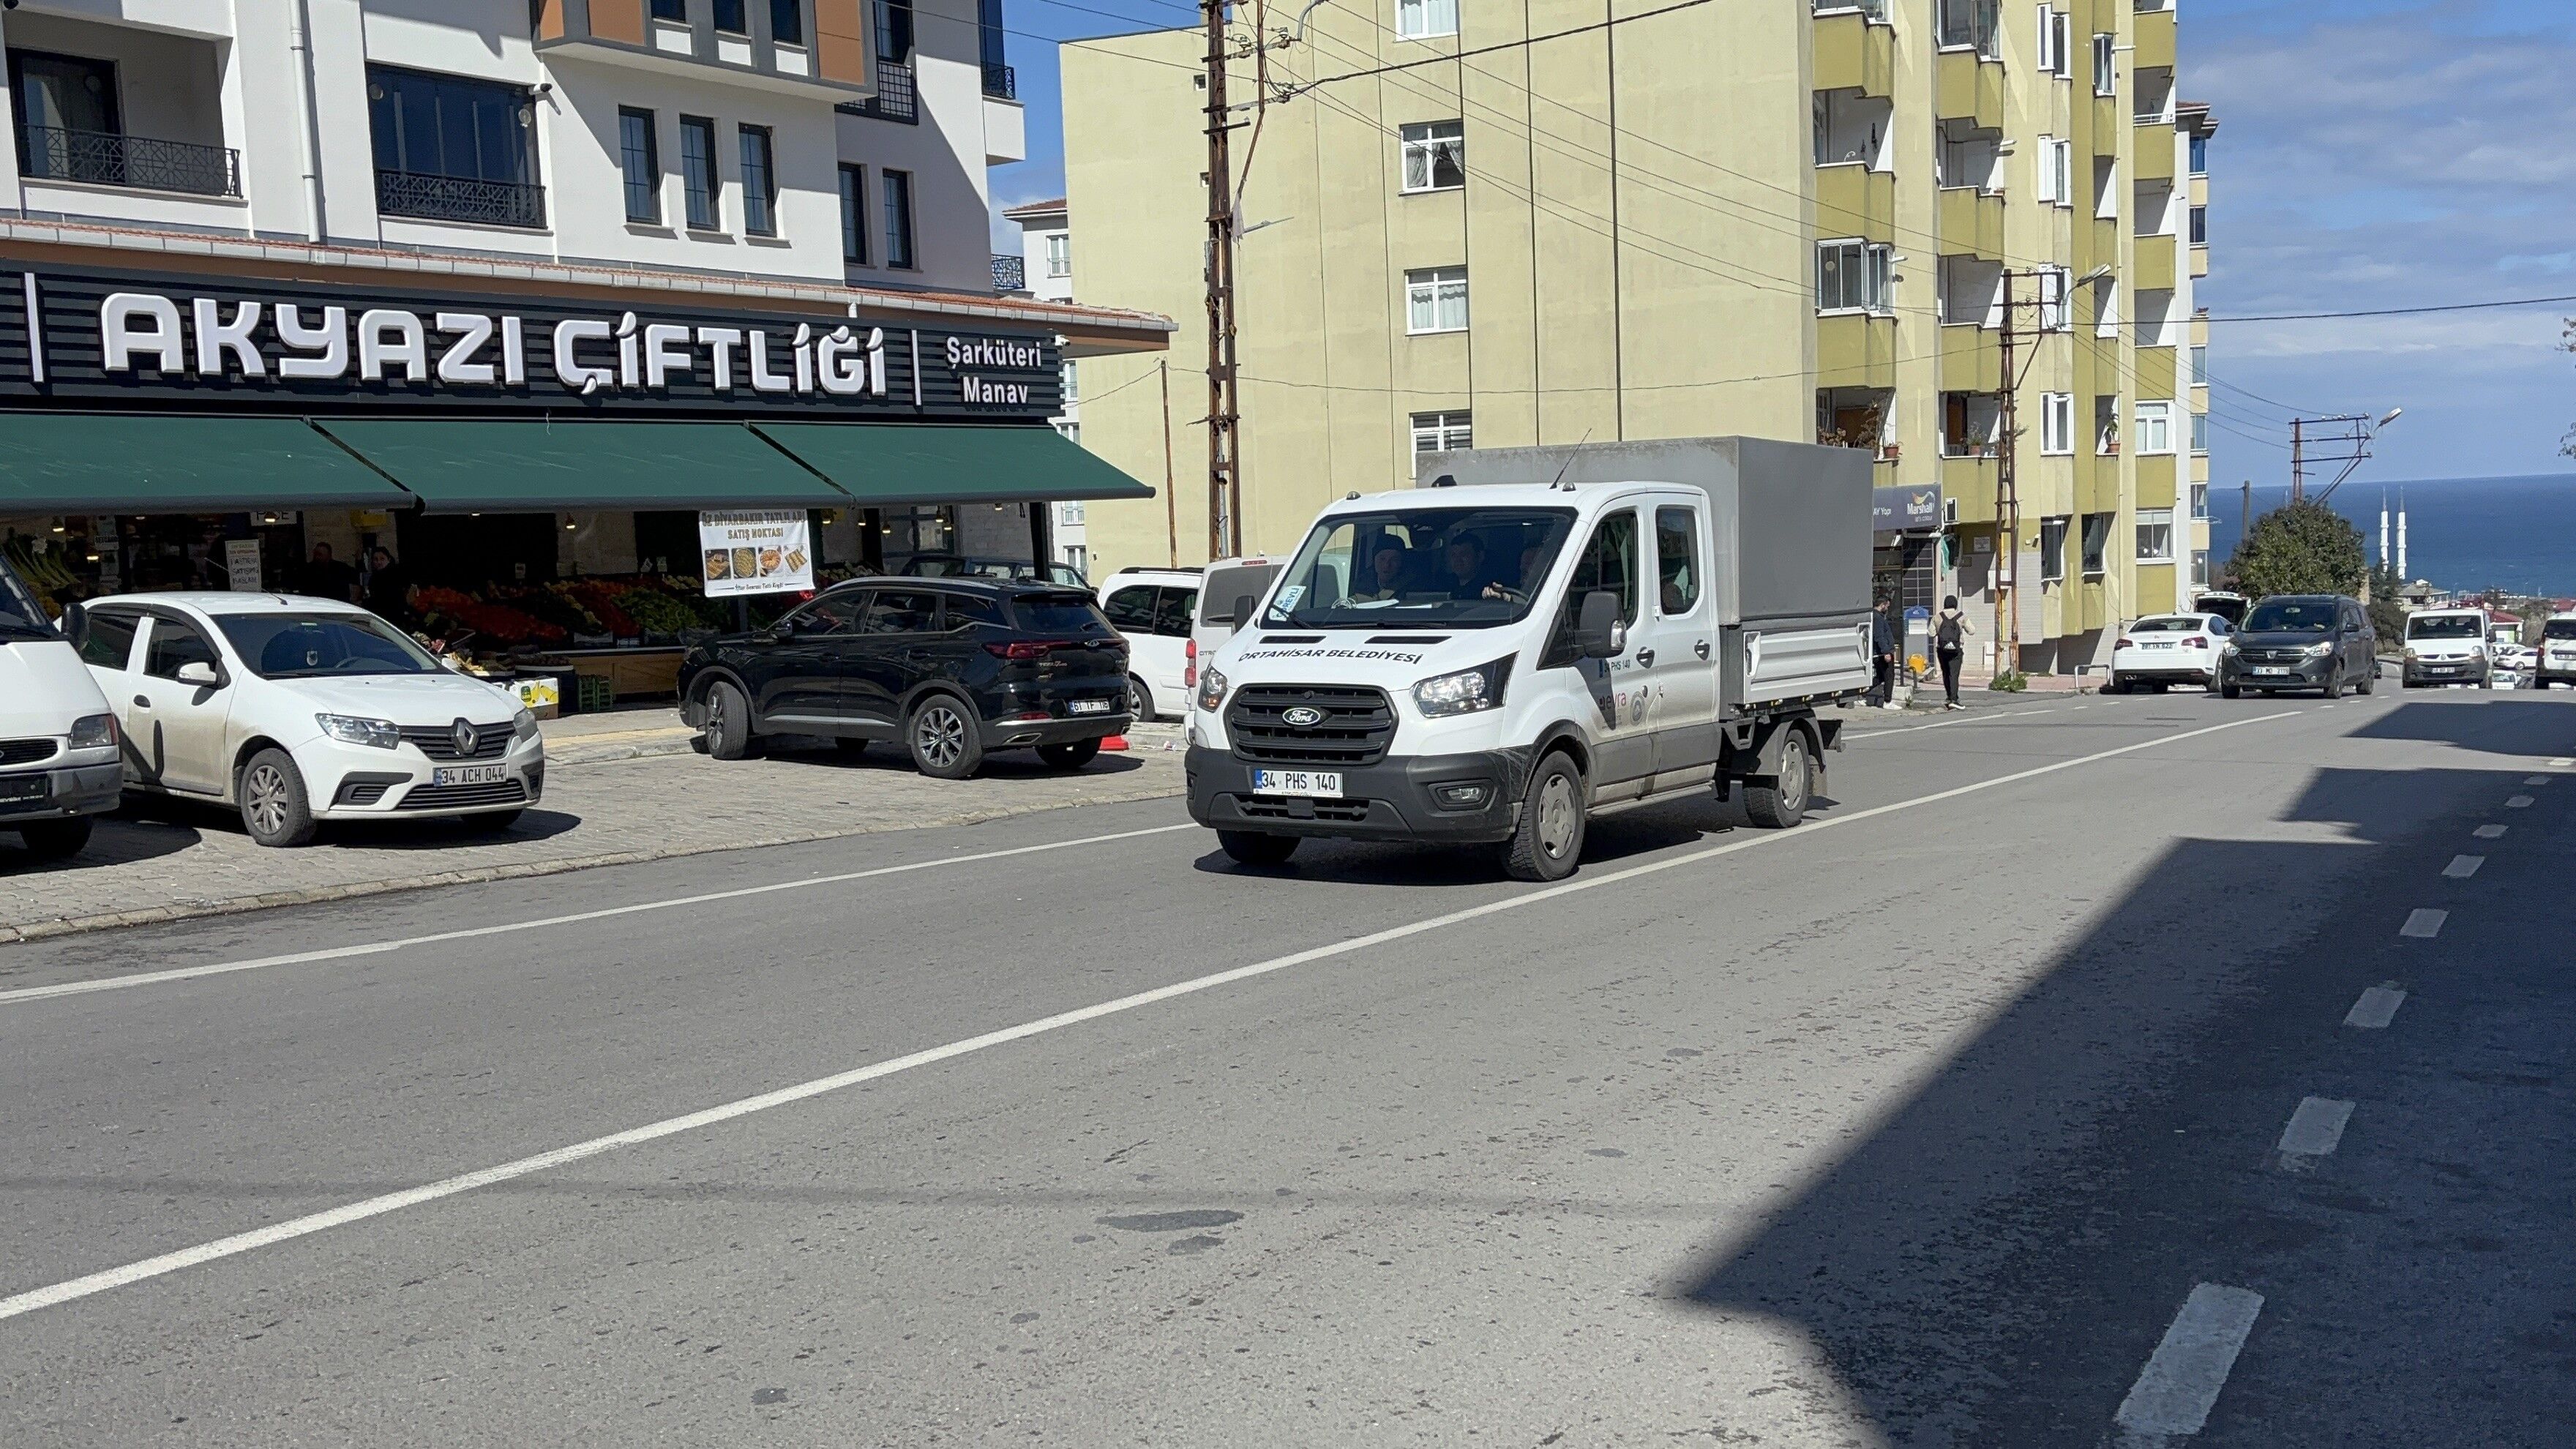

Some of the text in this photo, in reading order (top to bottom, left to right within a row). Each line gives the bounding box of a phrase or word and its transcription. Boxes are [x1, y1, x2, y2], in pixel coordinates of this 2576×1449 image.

[100, 292, 885, 396] AKYAZI ÇİFTLİĞİ
[946, 336, 1042, 370] Şarküteri
[962, 376, 1028, 405] Manav
[1906, 501, 1934, 514] Marshall
[727, 527, 784, 541] SATIŞ NOKTASI
[1238, 648, 1424, 664] ORTAHİSAR BELEDİYESİ
[1611, 661, 1621, 671] PHS
[1074, 700, 1082, 711] 61
[1289, 710, 1314, 722] Ford
[442, 766, 504, 784] 34 ACH 044
[1262, 772, 1336, 791] 34 PHS 140
